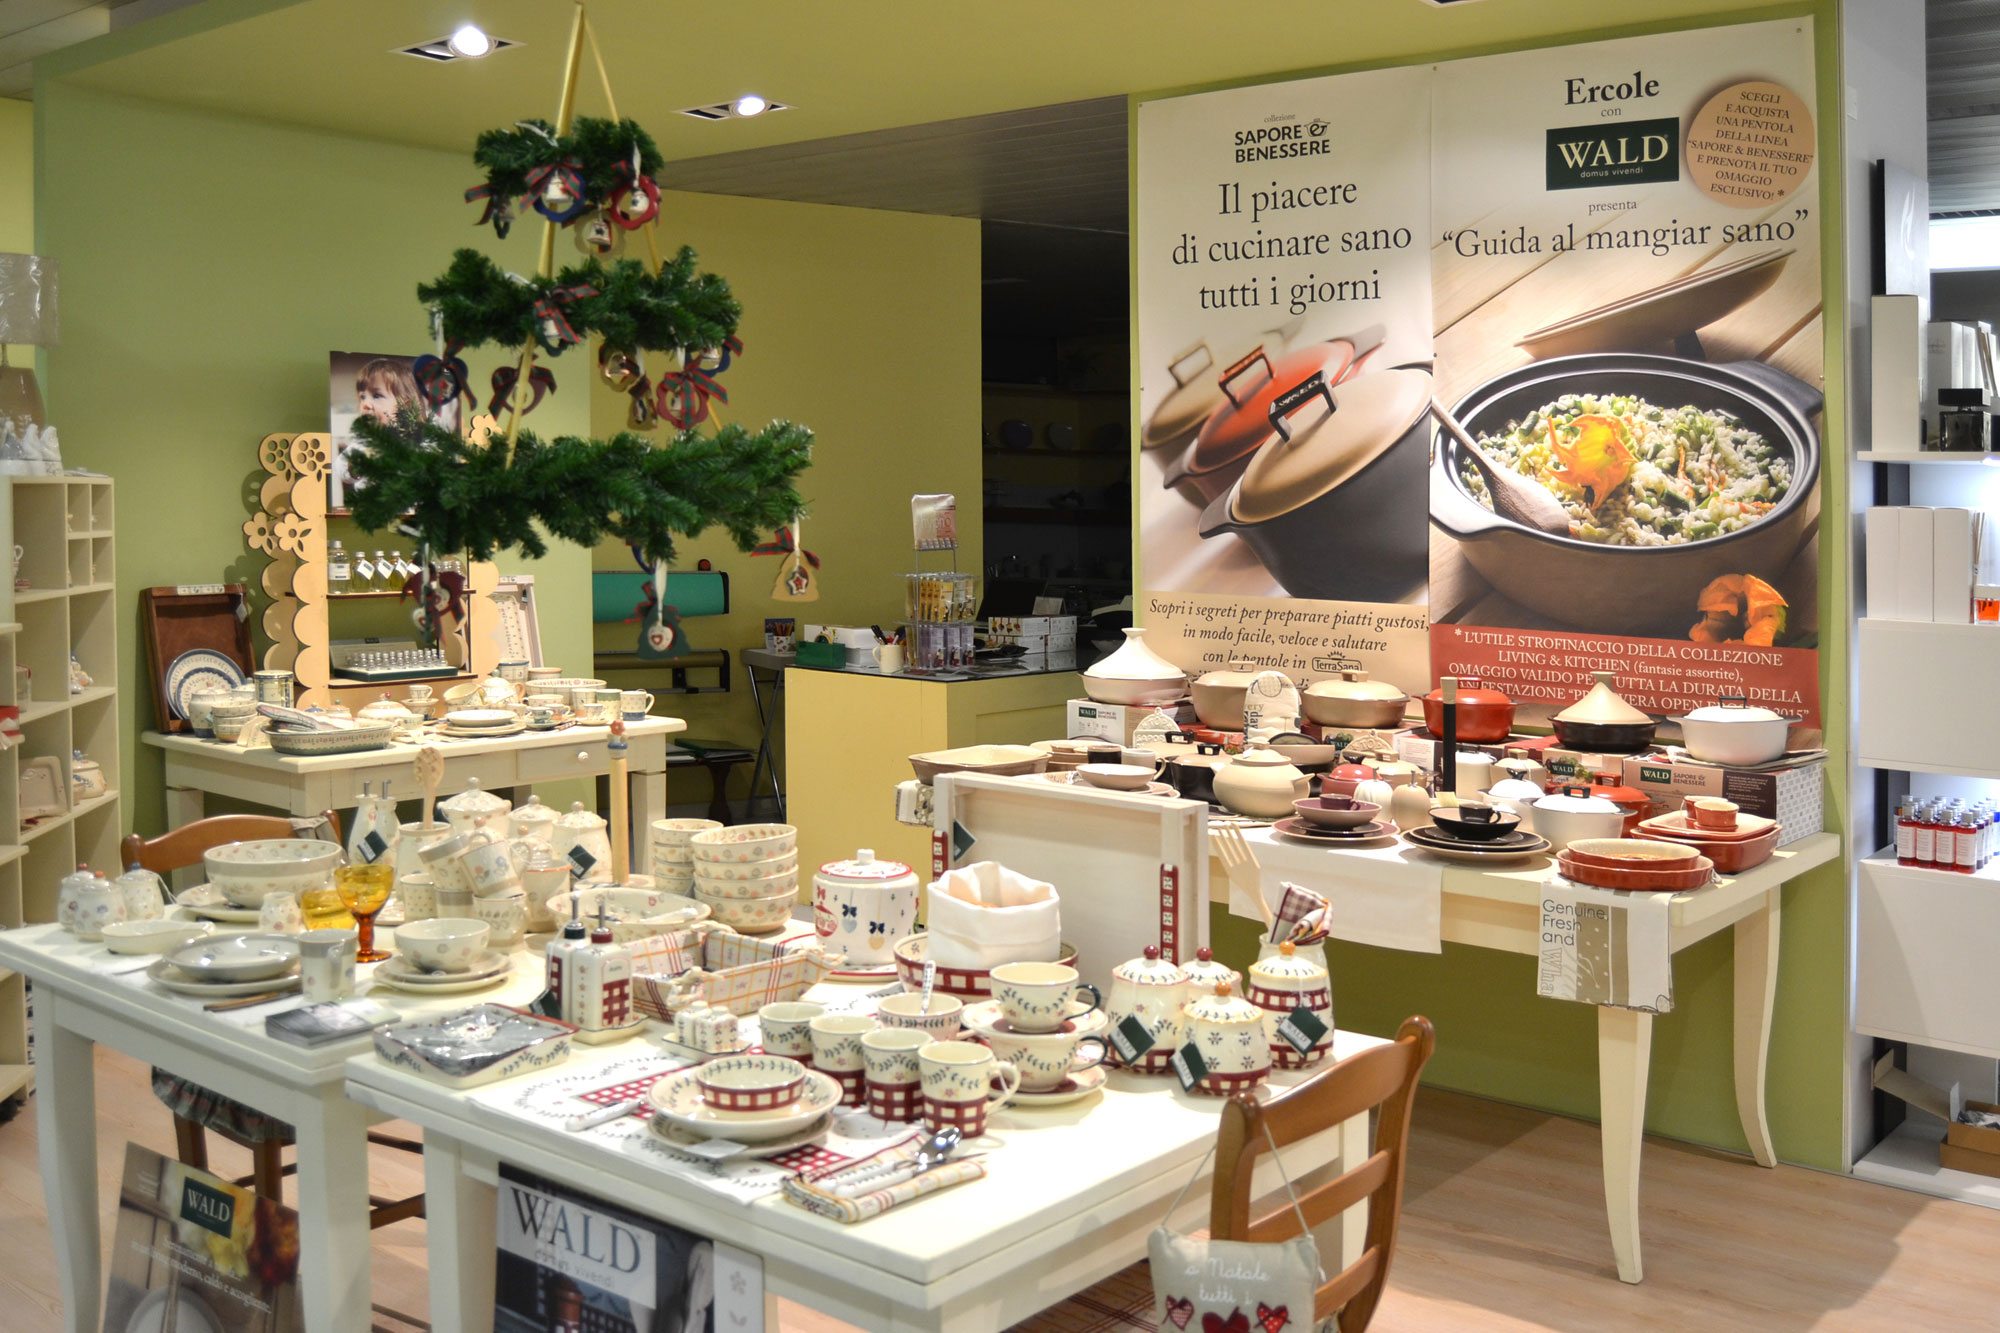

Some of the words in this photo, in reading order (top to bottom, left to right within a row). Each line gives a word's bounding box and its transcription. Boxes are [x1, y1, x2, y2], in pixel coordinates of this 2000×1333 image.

[1564, 71, 1659, 105] Ercole
[1740, 91, 1781, 104] SCEGLI
[1264, 114, 1296, 123] collezione
[1601, 106, 1621, 117] con
[1726, 104, 1733, 112] E
[1735, 105, 1790, 119] ACQUISTA
[1234, 124, 1302, 146] SAPORE
[1716, 116, 1738, 127] UNA
[1741, 119, 1794, 134] PENTOLA
[1715, 129, 1751, 143] DELLA
[1754, 134, 1789, 147] LINEA
[1235, 139, 1331, 163] BENESSERE
[1557, 136, 1669, 169] WALD
[1735, 146, 1744, 155] &
[1580, 168, 1608, 179] domus
[1611, 166, 1644, 177] vivendi
[1697, 154, 1704, 163] E
[1706, 155, 1757, 170] PRENOTA
[1759, 163, 1770, 172] IL
[1772, 163, 1798, 176] TUO
[1715, 170, 1772, 186] OMAGGIO
[1710, 183, 1775, 200] ESCLUSIVO!
[1218, 182, 1241, 215] Il
[1251, 181, 1358, 223] piacere
[1588, 200, 1638, 216] presenta
[1173, 234, 1199, 265] di
[1208, 230, 1330, 262] cucinare
[1341, 226, 1412, 253] sano
[1552, 223, 1574, 252] al
[1586, 219, 1711, 257] mangiar
[1200, 277, 1260, 309] tutti
[1270, 276, 1279, 306] i
[1289, 269, 1382, 316] giorni
[1149, 599, 1185, 620] Scopri
[1188, 600, 1194, 615] i
[1196, 603, 1237, 622] segreti
[1239, 606, 1262, 624] per
[1263, 607, 1330, 628] preparare
[1332, 610, 1372, 630] piatti
[1375, 614, 1430, 633] gustosi,
[1183, 623, 1196, 638] in
[1199, 626, 1234, 641] modo
[1234, 627, 1276, 646] facile,
[1279, 633, 1319, 648] veloce
[1322, 637, 1329, 648] e
[1331, 635, 1388, 652] salutare
[1203, 650, 1224, 663] con
[1228, 649, 1239, 662] le
[1240, 651, 1290, 670] pentole
[1292, 654, 1306, 669] in
[1518, 635, 1624, 655] STROFINACCIO
[1627, 643, 1677, 659] DELLA
[1680, 647, 1783, 666] COLLEZIONE
[1498, 650, 1546, 665] LIVING
[1550, 655, 1562, 667] &
[1564, 655, 1630, 672] KITCHEN
[1633, 660, 1682, 676] (fantasie
[1685, 666, 1744, 683] assortite),
[1449, 662, 1517, 680] OMAGGIO
[1520, 668, 1573, 684] VALIDO
[1576, 673, 1594, 686] PE
[1659, 680, 1680, 693] LA
[1683, 682, 1745, 698] DURATA
[1749, 687, 1803, 704] DELLA
[1661, 696, 1704, 711] OPEN
[1552, 764, 1574, 773] WALD
[1643, 769, 1669, 780] WALD
[1673, 773, 1697, 781] SAPORE
[1673, 778, 1706, 787] BENESSERE
[1542, 914, 1582, 932] Fresh
[1542, 931, 1575, 946] and
[187, 1187, 231, 1224] WALD
[510, 1186, 642, 1274] WALD
[1208, 1257, 1271, 1283] Natale
[1199, 1284, 1237, 1304] tutti
